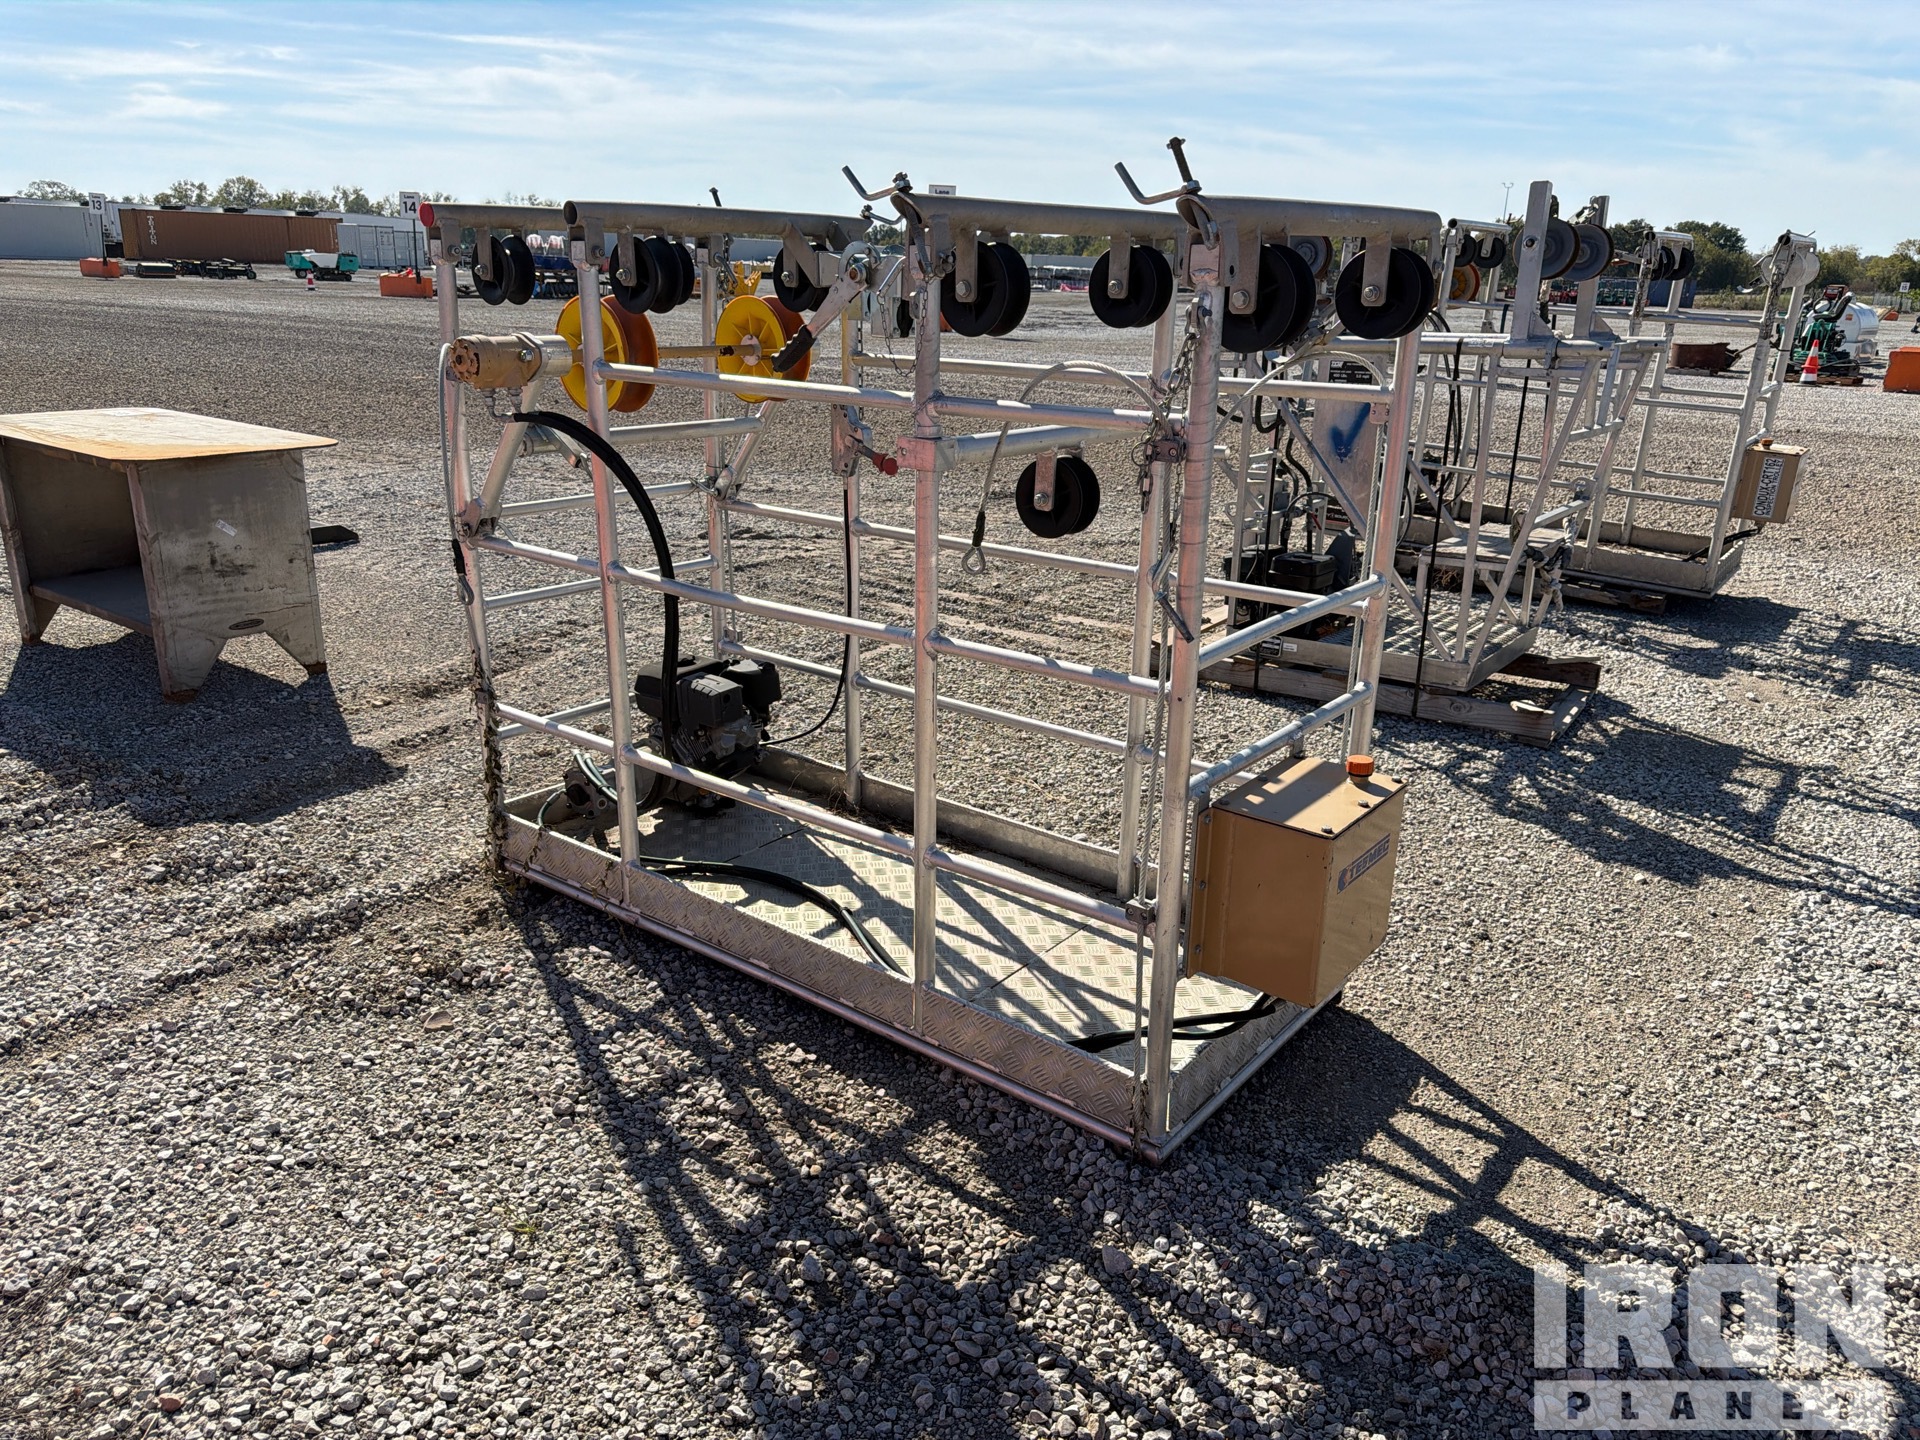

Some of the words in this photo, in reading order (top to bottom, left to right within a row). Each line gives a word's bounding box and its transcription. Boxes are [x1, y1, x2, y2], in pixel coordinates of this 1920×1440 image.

[92, 200, 102, 210] 13
[403, 201, 417, 214] 14
[1754, 458, 1777, 516] CONDUX-CRT162
[1765, 485, 1777, 516] INSPECTION
[1771, 460, 1783, 484] TROLLEY
[1350, 838, 1390, 879] TESMEC
